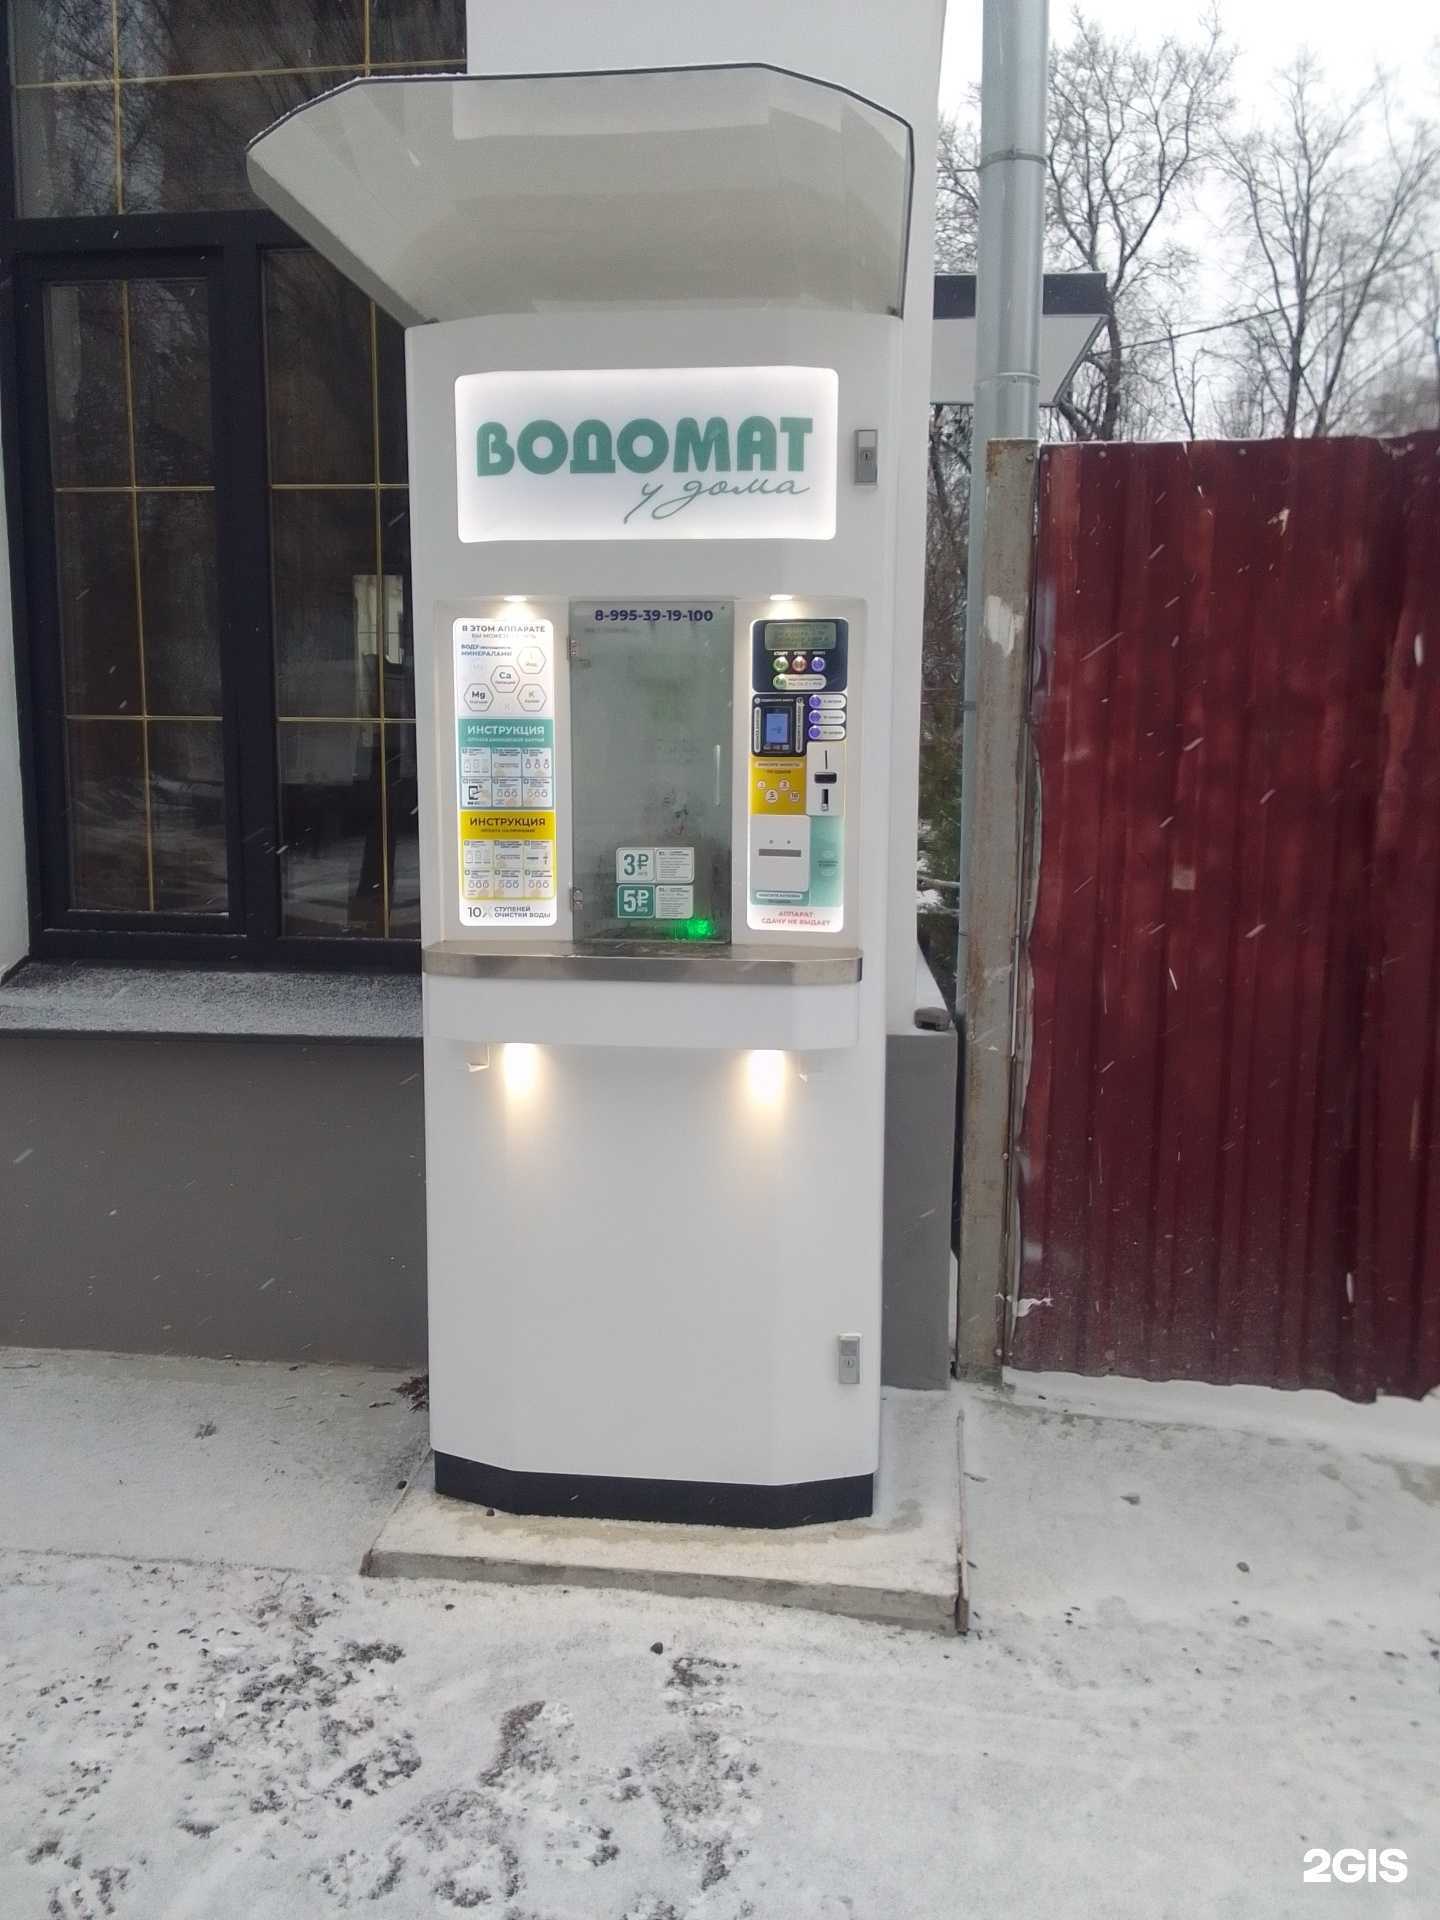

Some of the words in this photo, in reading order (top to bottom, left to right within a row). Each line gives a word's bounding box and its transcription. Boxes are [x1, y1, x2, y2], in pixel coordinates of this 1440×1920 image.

[477, 416, 813, 477] ВОДОМАТ
[624, 482, 663, 524] у
[651, 479, 810, 520] дома
[594, 609, 714, 622] 8-995-39-19-100
[497, 625, 546, 633] АППАРАТЕ
[499, 672, 512, 680] Ca
[472, 691, 486, 700] Mg
[467, 726, 545, 736] ИНСТРУКЦИЯ
[470, 817, 546, 827] ИНСТРУКЦИЯ
